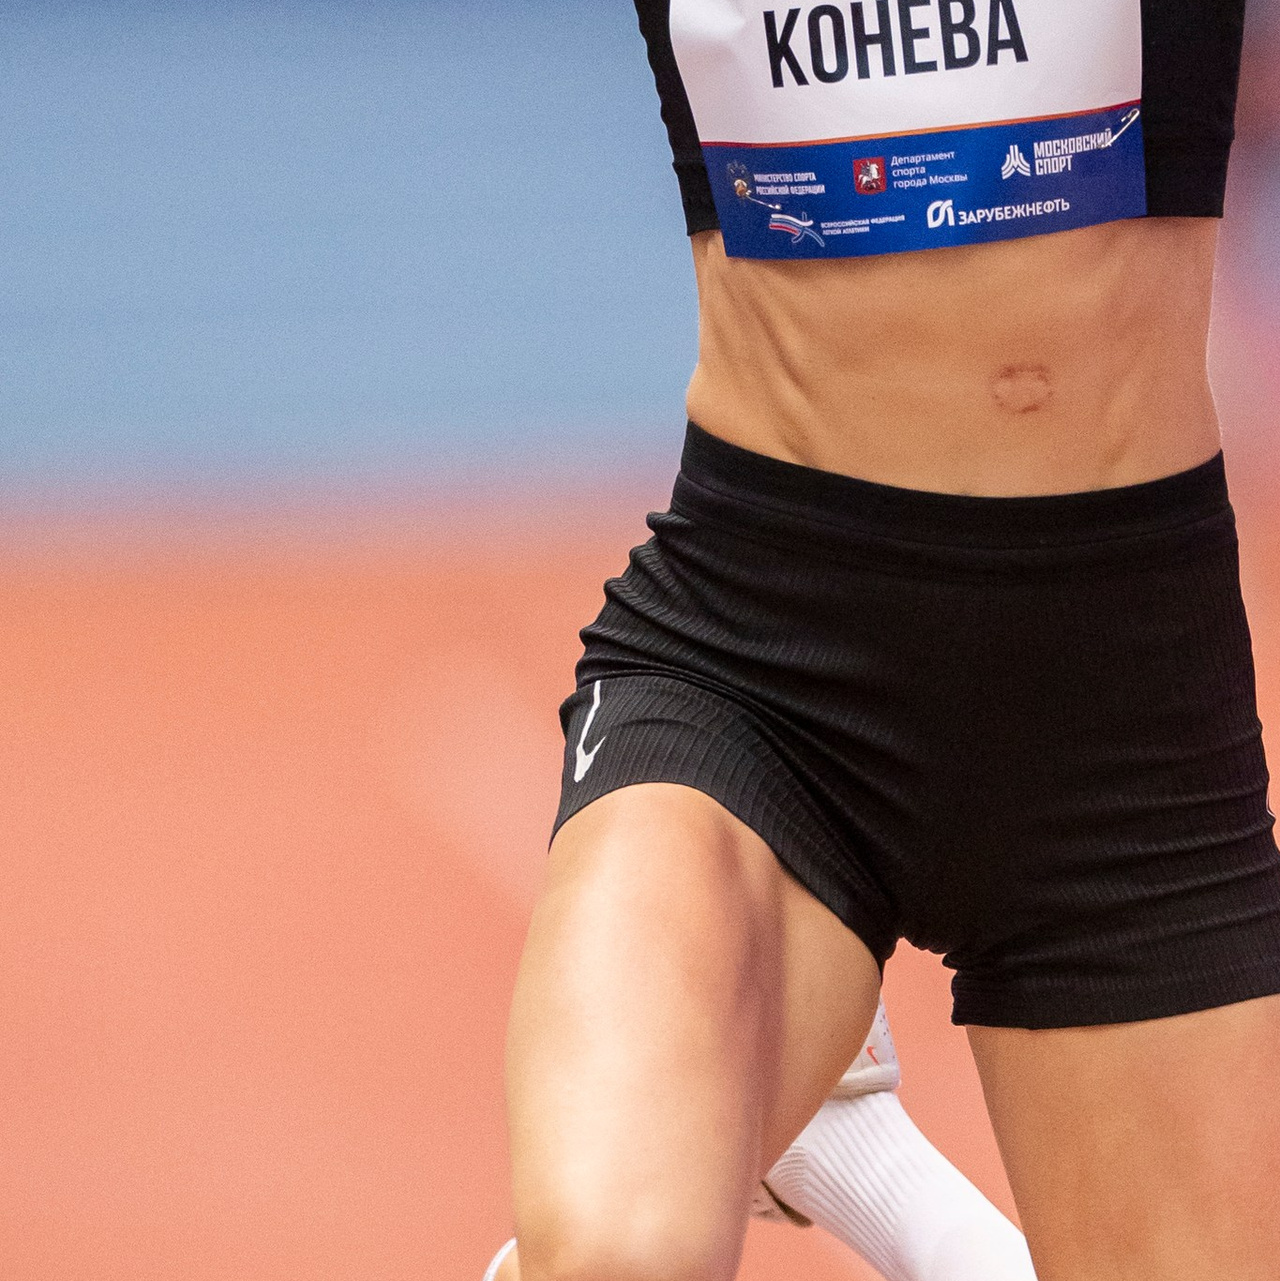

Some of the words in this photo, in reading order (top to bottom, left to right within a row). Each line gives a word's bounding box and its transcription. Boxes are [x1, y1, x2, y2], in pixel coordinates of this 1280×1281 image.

[1033, 128, 1112, 159] МОСКОВСКИЙ
[890, 151, 955, 167] Департамент
[1035, 155, 1073, 176] СПОРТ
[892, 166, 926, 178] спорта
[893, 178, 927, 190] города
[929, 174, 968, 185] Москвы
[958, 198, 1070, 226] ЗАРУБЕЖНЕФТЬ
